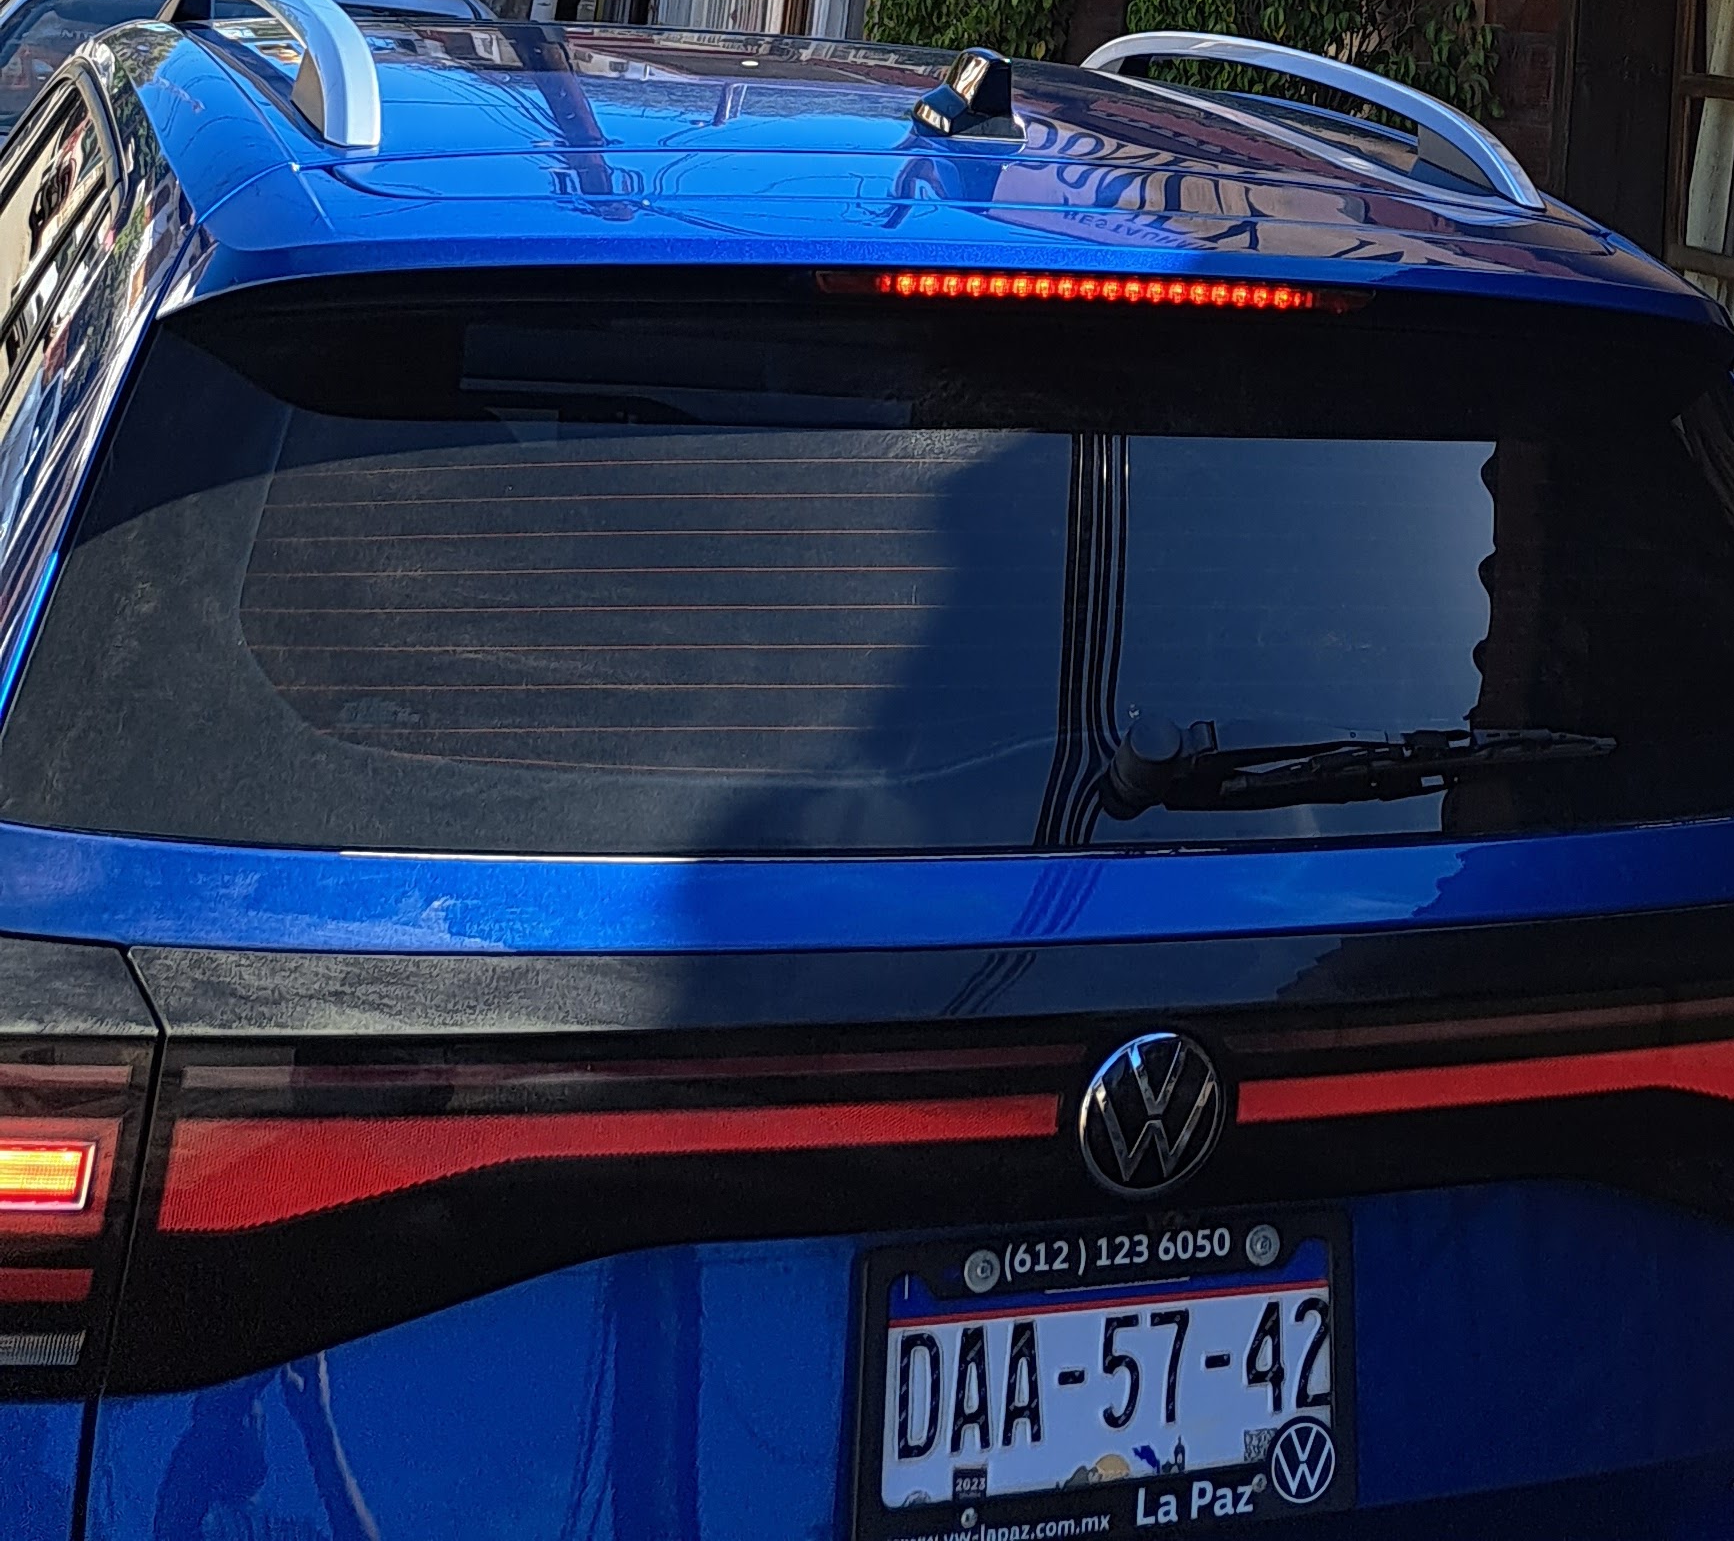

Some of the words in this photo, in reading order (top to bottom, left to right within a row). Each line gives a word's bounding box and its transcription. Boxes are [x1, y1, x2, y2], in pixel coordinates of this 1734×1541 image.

[1095, 1233, 1150, 1268] 123
[1157, 1226, 1231, 1260] 6050
[896, 1297, 1332, 1461] DAA-57-42
[955, 1477, 986, 1492] 2023
[1136, 1487, 1179, 1527] La
[1190, 1480, 1254, 1520] Paz
